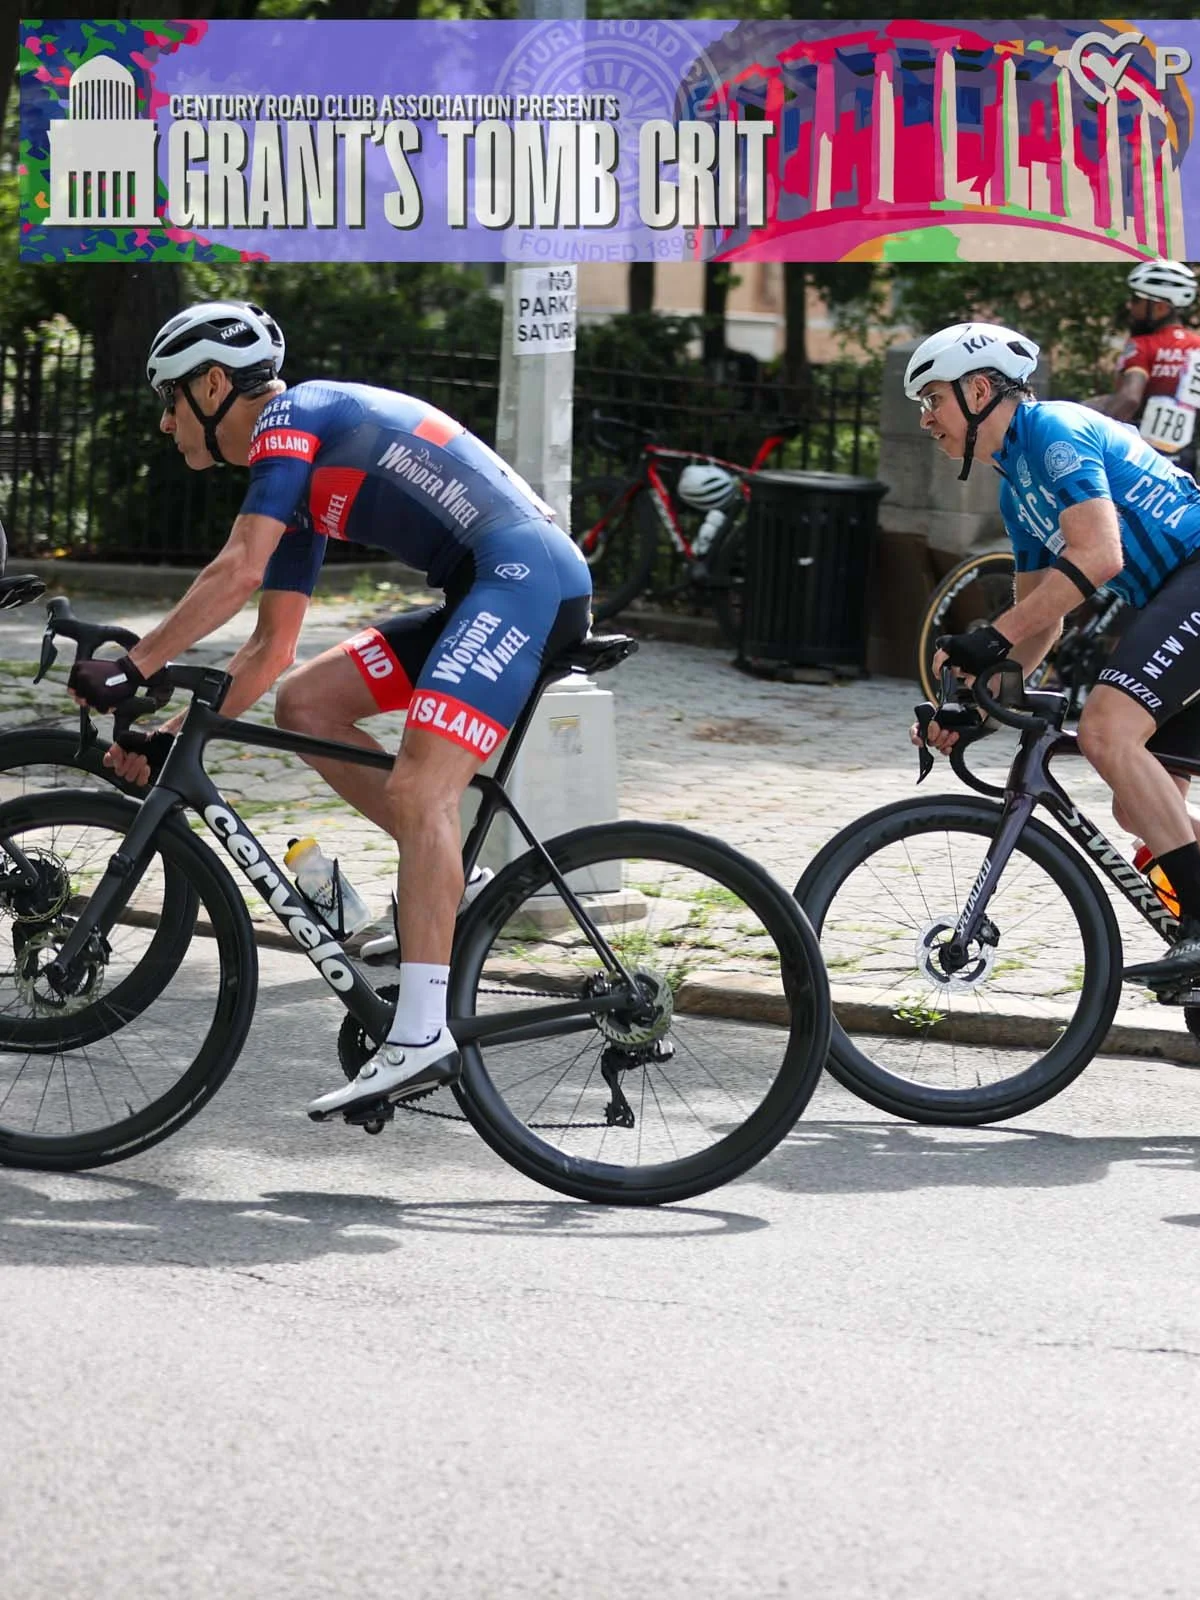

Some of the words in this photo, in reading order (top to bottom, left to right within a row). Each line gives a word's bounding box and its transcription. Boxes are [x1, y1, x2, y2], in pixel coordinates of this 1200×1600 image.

[519, 295, 569, 317] PARK
[517, 321, 572, 342] SATUR
[962, 334, 995, 354] KA
[265, 435, 309, 454] ISLAND
[1151, 407, 1187, 442] 178
[377, 442, 445, 497] WONDER
[437, 478, 479, 529] WHEEL
[1124, 474, 1190, 529] CRCA
[432, 611, 502, 684] WONDER
[470, 626, 531, 682] WHEEL
[1142, 635, 1185, 679] NEW
[411, 696, 498, 754] ISLAND
[1057, 807, 1180, 943] S-WORK
